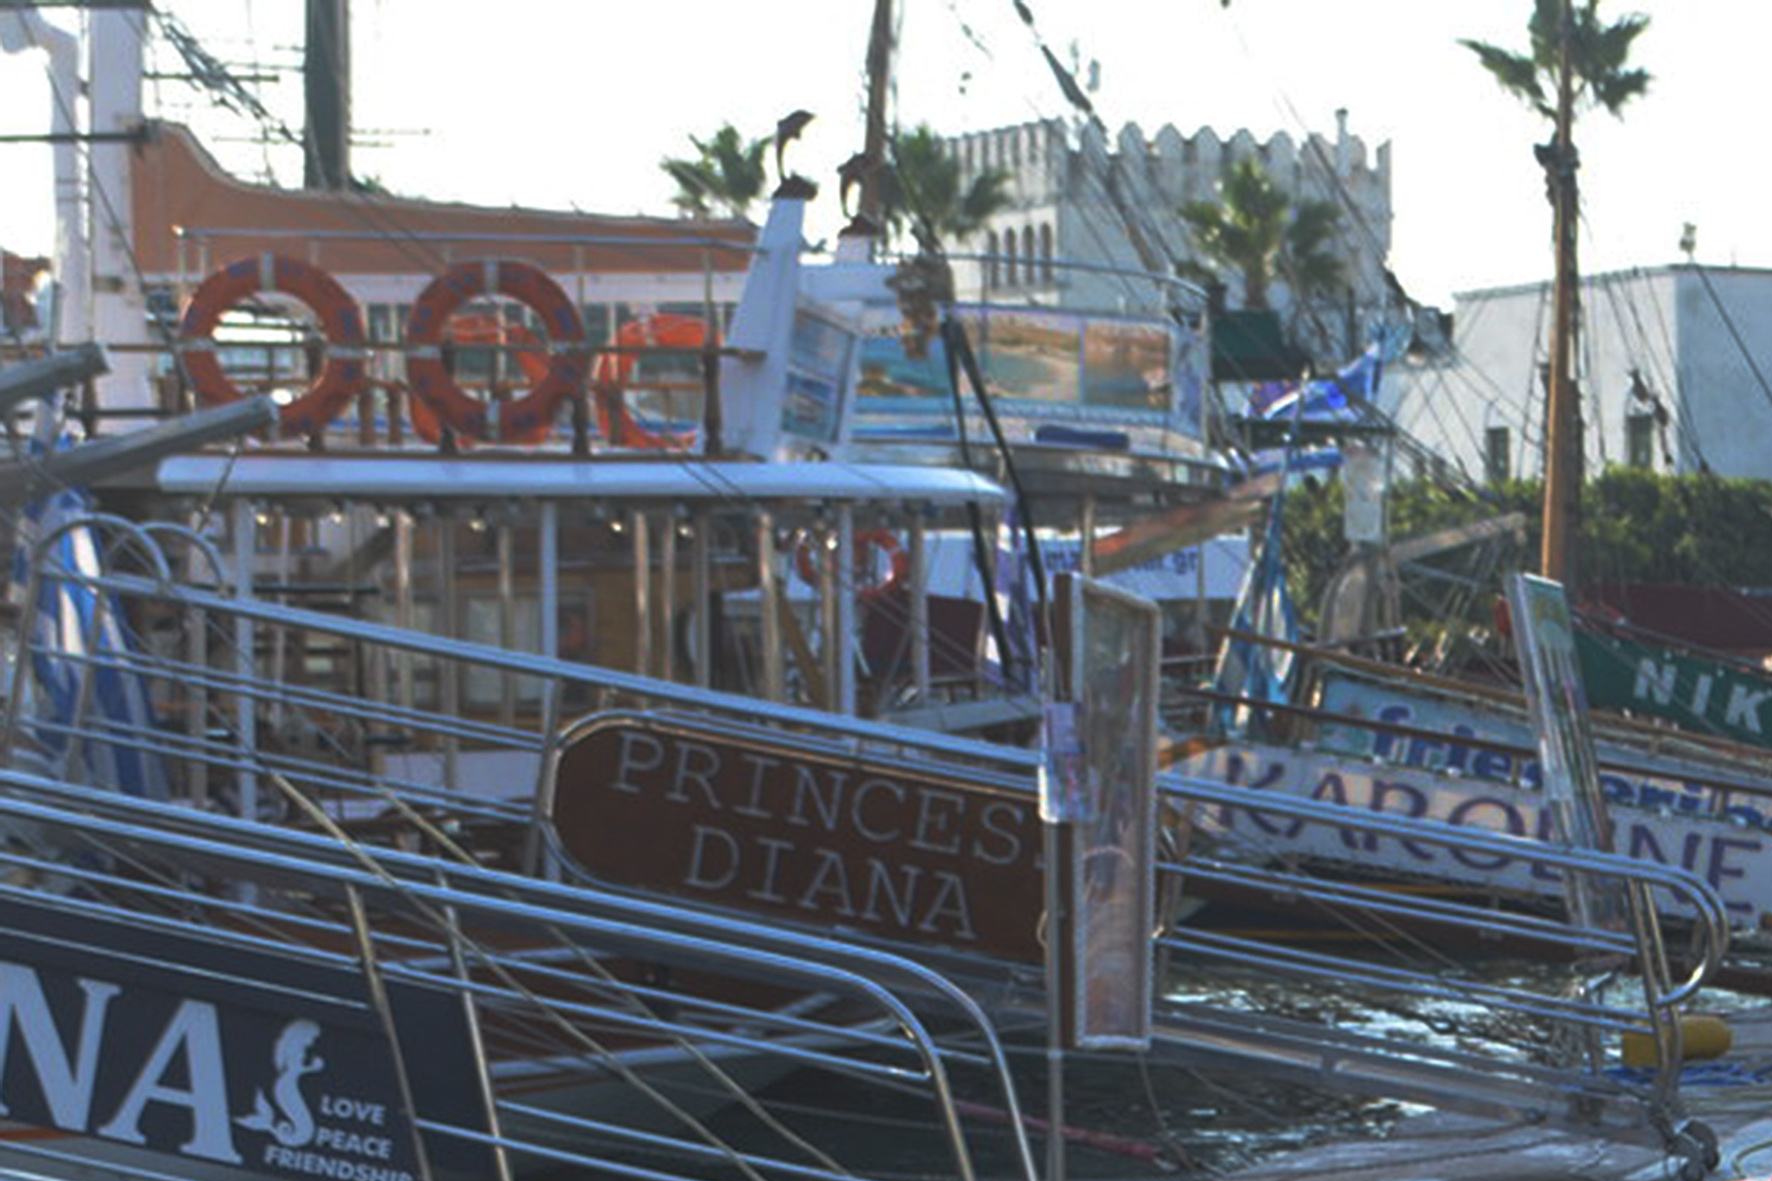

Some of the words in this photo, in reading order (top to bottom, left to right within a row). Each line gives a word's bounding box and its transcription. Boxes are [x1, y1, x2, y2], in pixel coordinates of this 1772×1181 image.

[613, 731, 1047, 868] PRINCES
[1223, 752, 1762, 914] KAROLNE
[685, 824, 977, 940] DIANA
[0, 961, 243, 1165] NA
[320, 1095, 386, 1126] LOVE
[315, 1128, 393, 1160] PEACE
